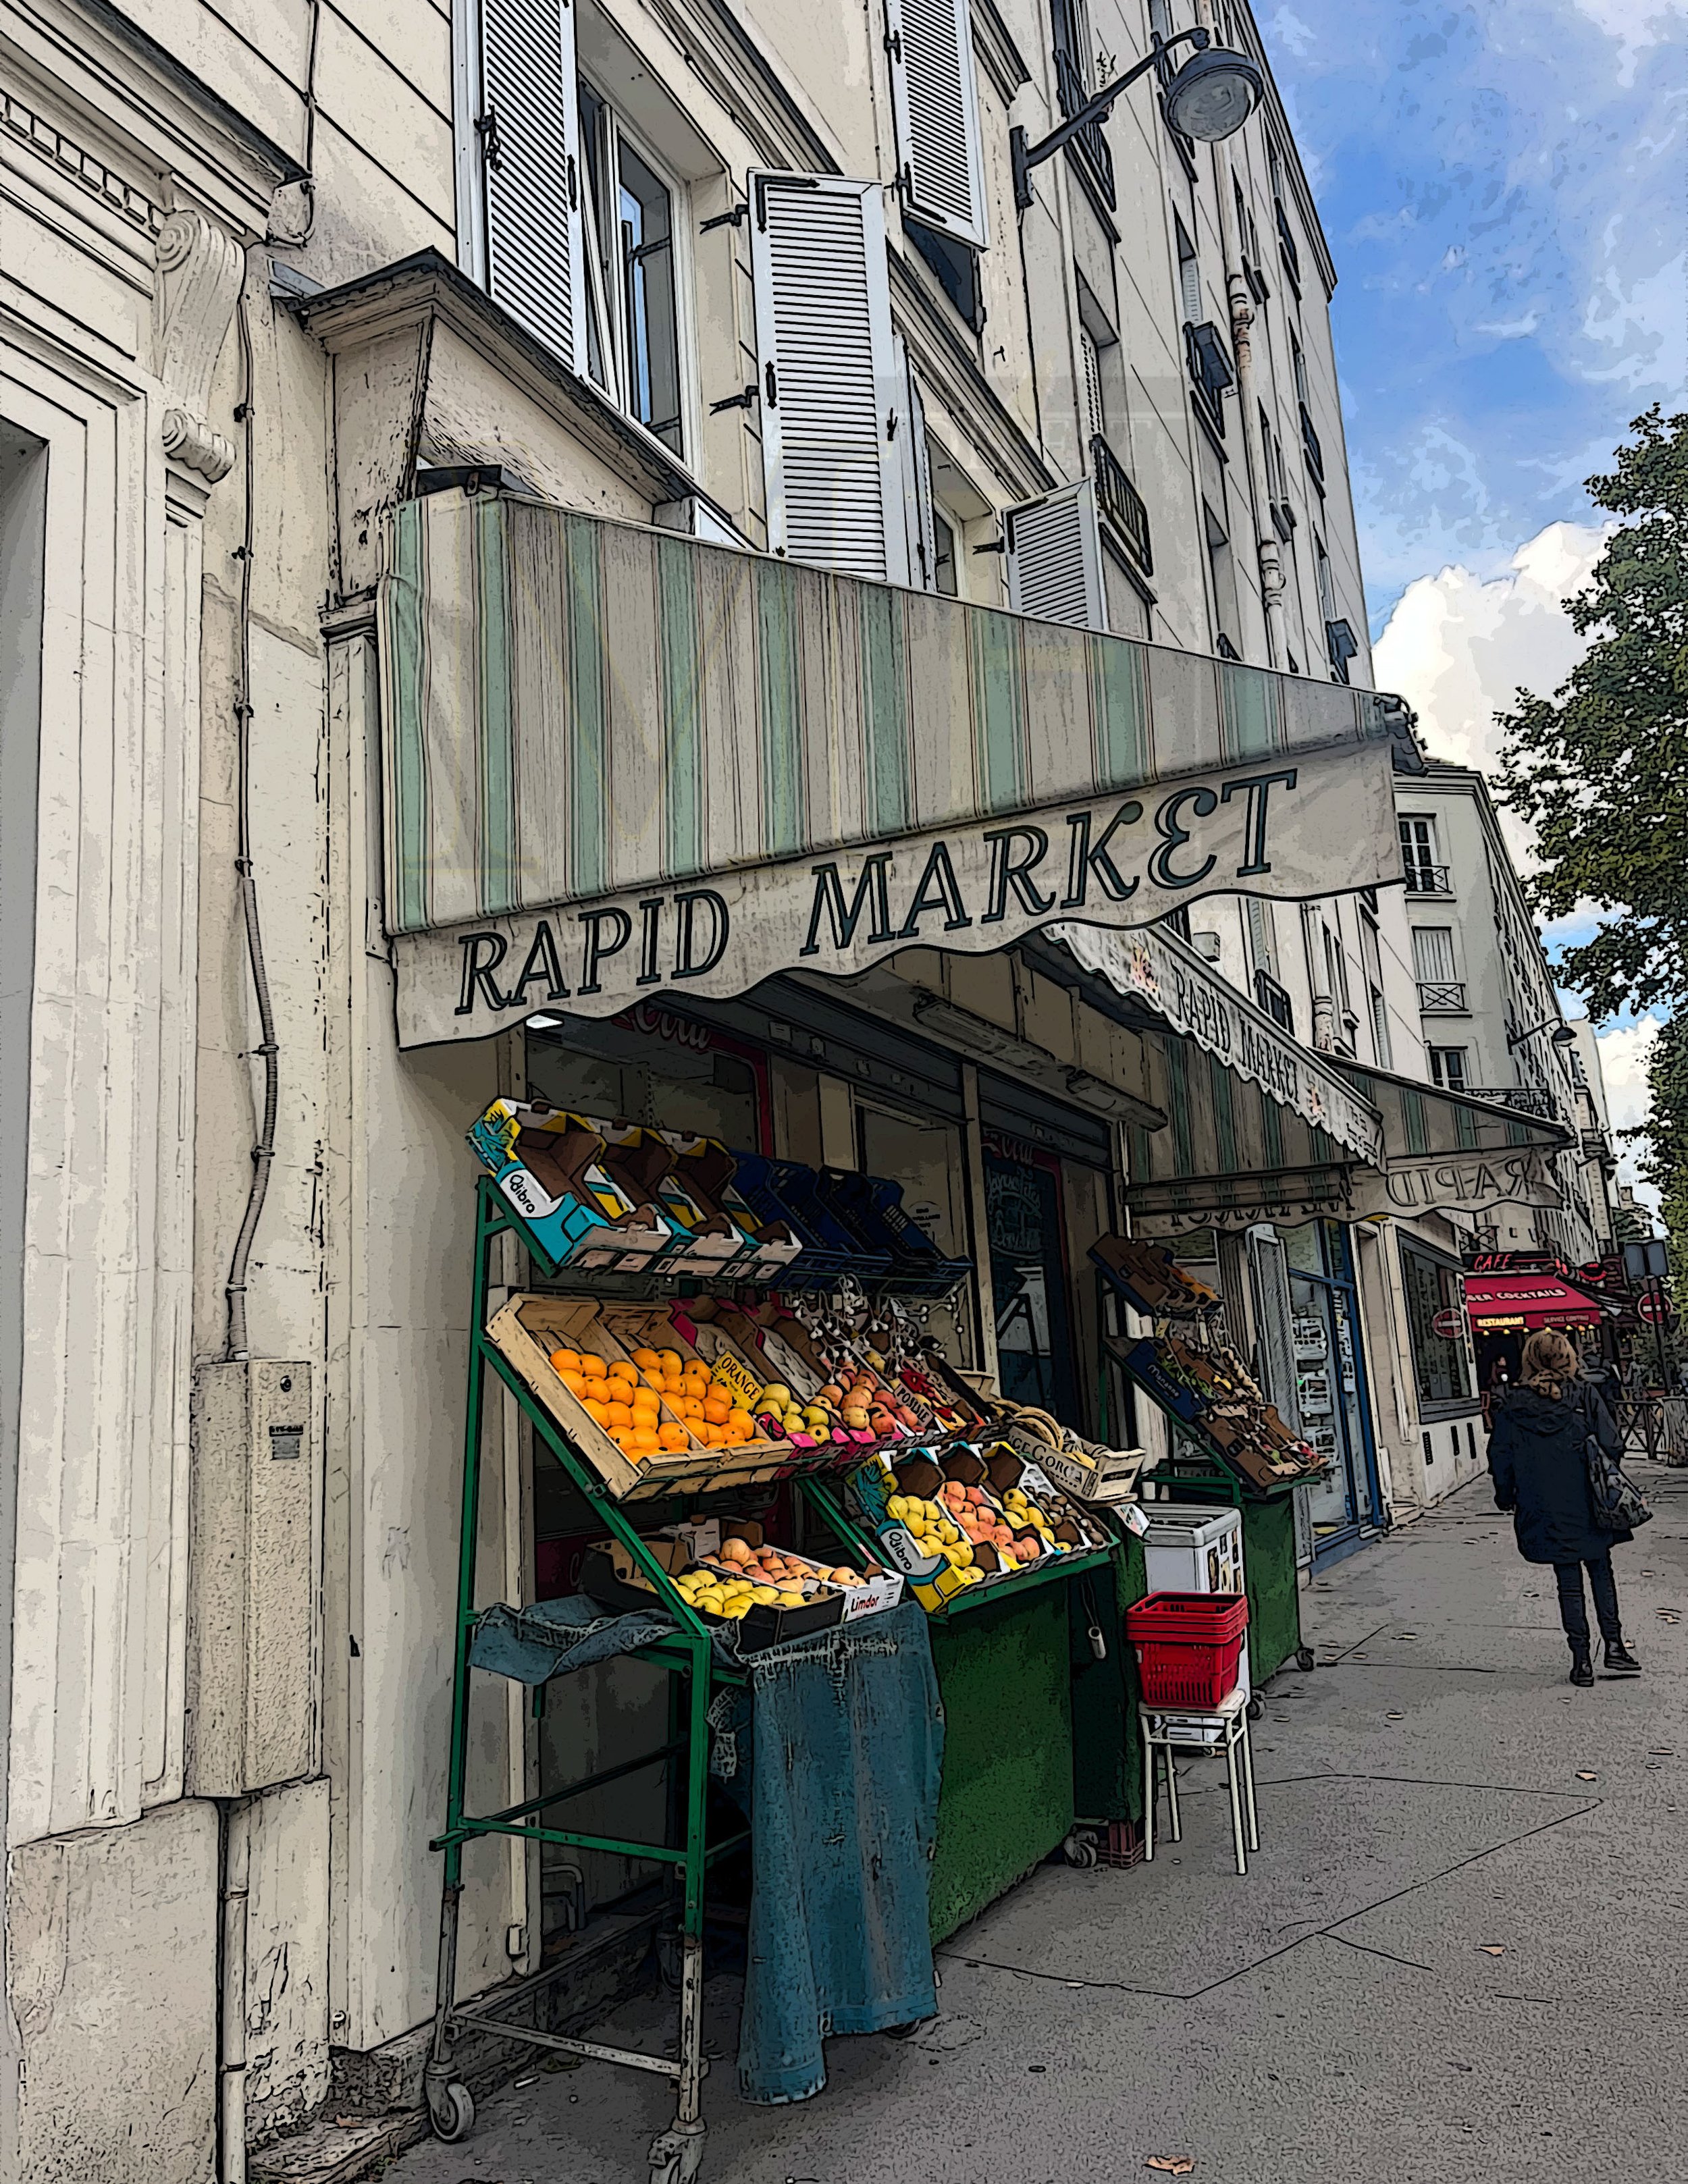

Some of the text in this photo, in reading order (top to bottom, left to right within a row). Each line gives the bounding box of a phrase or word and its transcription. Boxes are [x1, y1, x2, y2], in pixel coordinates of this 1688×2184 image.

[454, 768, 1298, 1016] RAPID MARKET
[1171, 959, 1232, 1054] RAPID
[1496, 1288, 1566, 1300] COCKTAILS
[1477, 1316, 1524, 1327] RESTAURANT
[722, 1357, 760, 1400] ORANGE
[851, 1595, 880, 1612] Limdor
